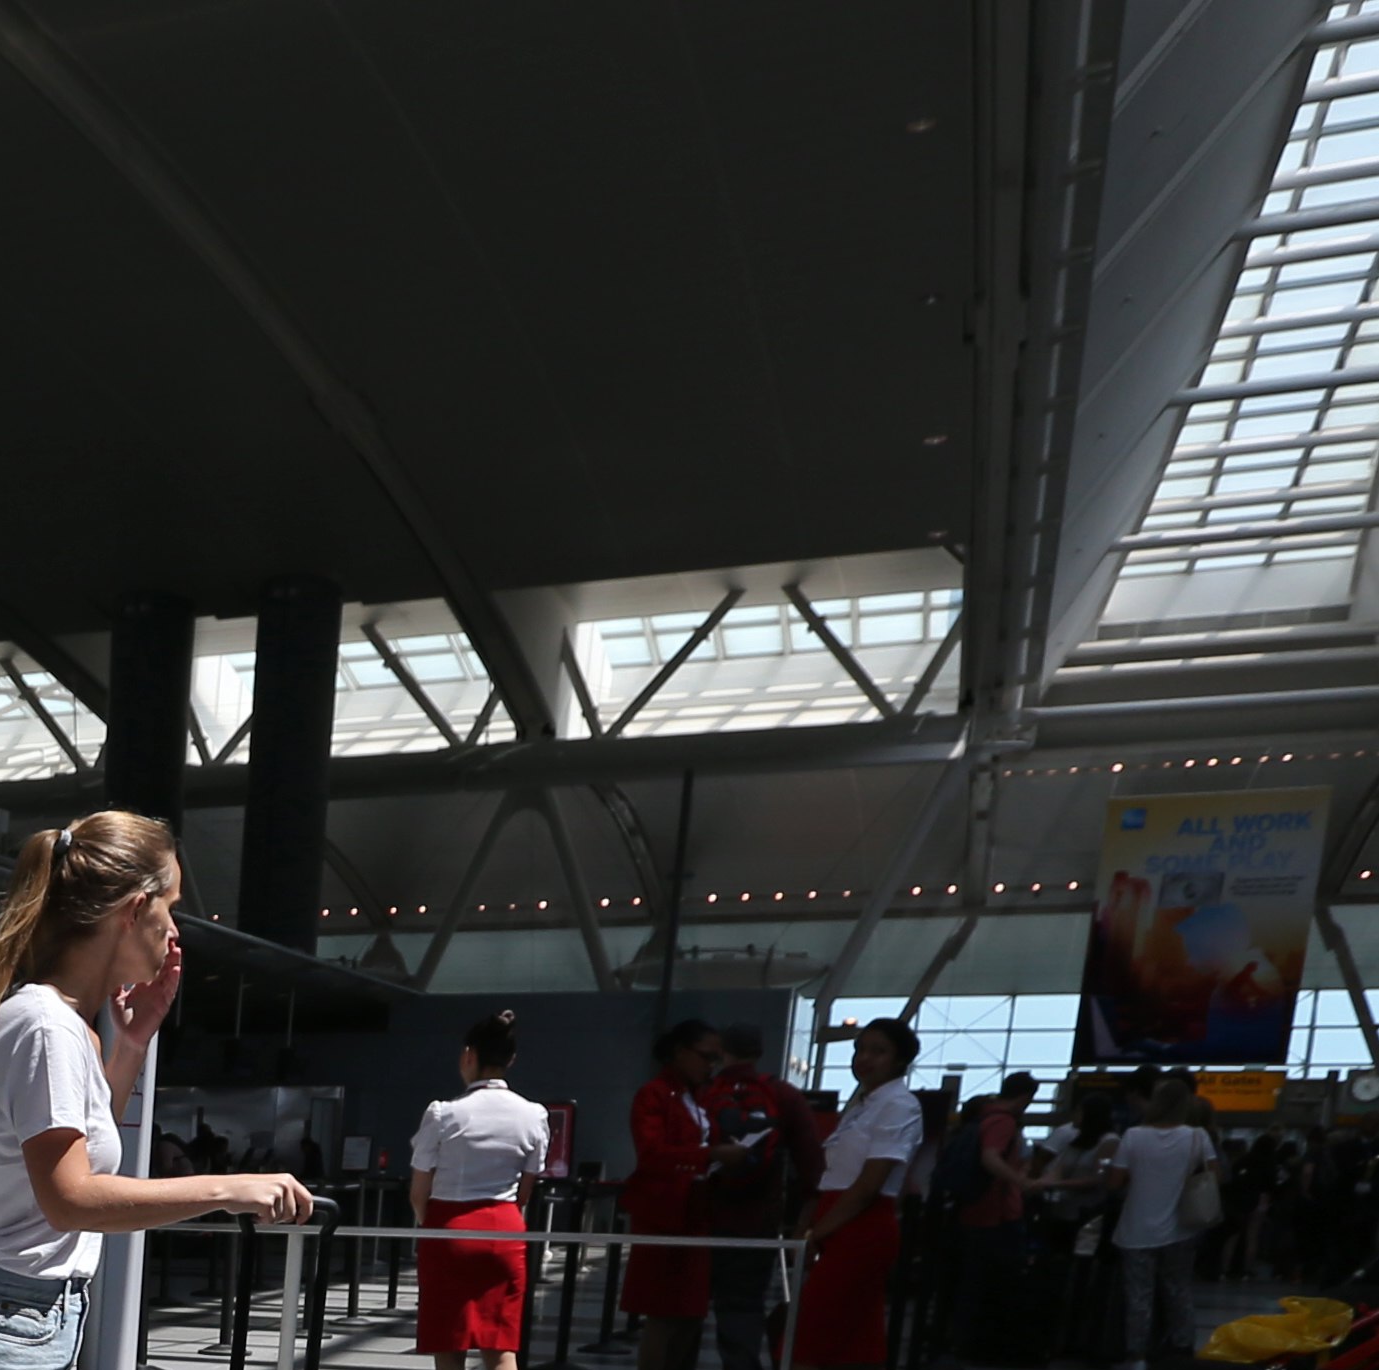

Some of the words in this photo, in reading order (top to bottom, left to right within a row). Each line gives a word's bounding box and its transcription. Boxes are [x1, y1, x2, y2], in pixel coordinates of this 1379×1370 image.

[1177, 816, 1223, 836] ALL
[1233, 809, 1313, 834] WORK
[1211, 833, 1265, 853] AND
[1147, 854, 1220, 874] SOME
[1227, 851, 1295, 871] PLAY
